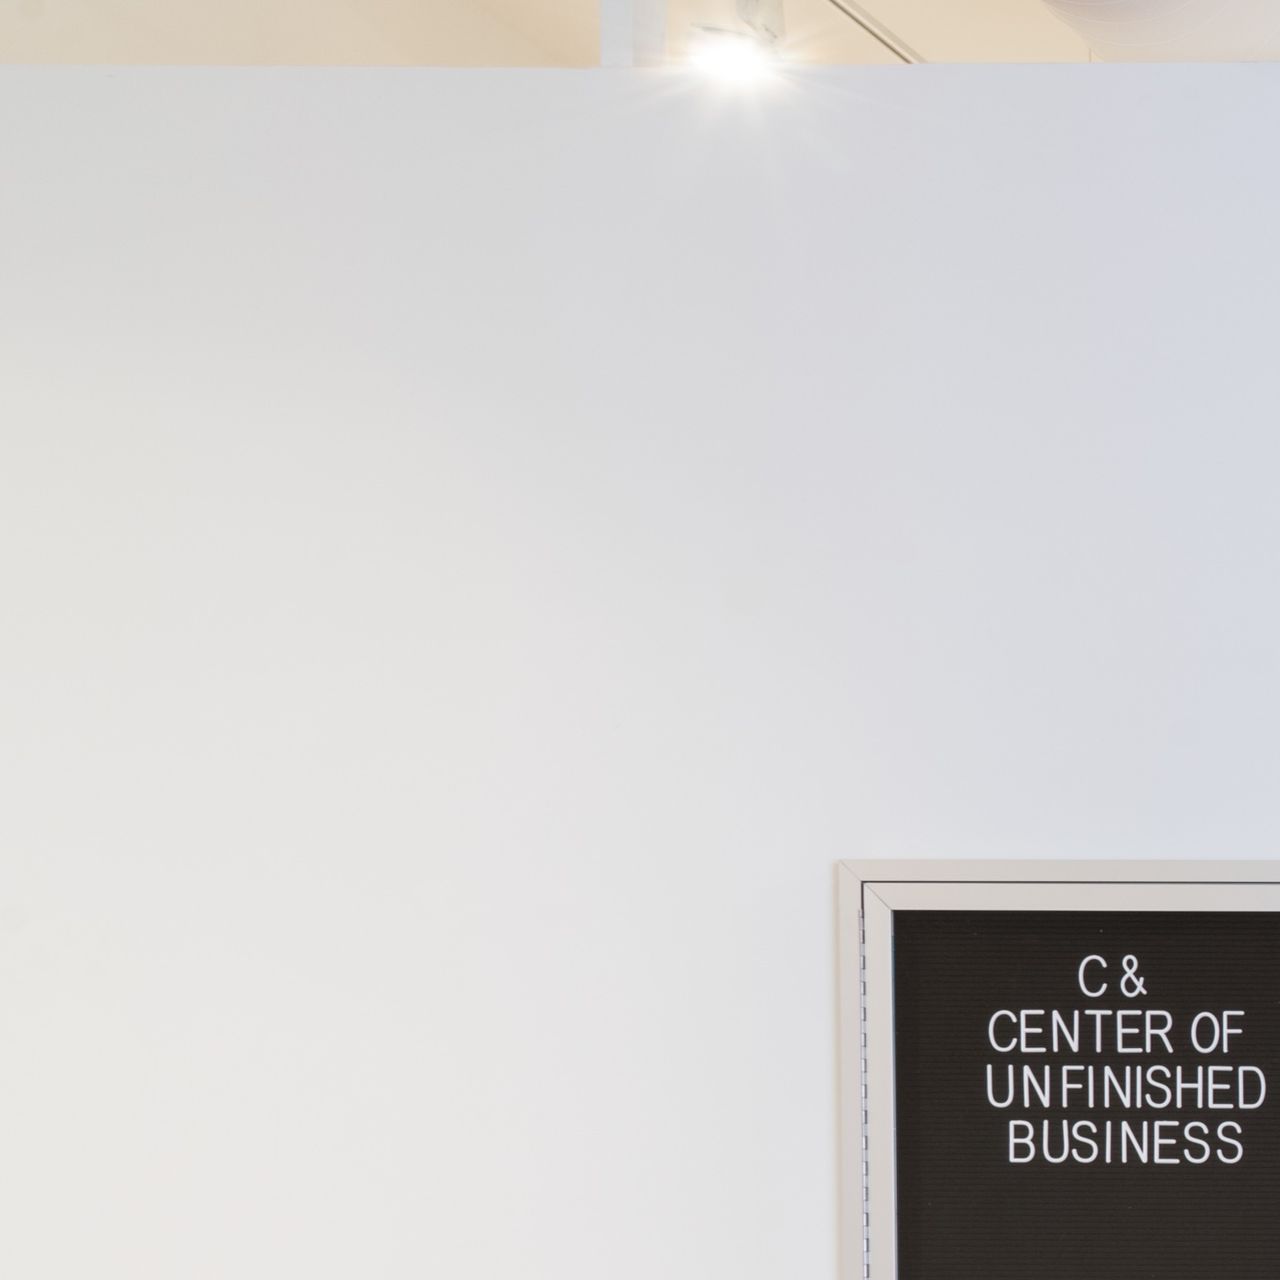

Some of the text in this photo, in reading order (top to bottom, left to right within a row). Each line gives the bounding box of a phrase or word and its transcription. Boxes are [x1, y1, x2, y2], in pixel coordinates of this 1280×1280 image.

[1079, 955, 1147, 997] C &
[989, 1010, 1244, 1053] CENTER OF
[987, 1064, 1266, 1109] UNFINISHED
[1009, 1120, 1243, 1164] BUSINESS
